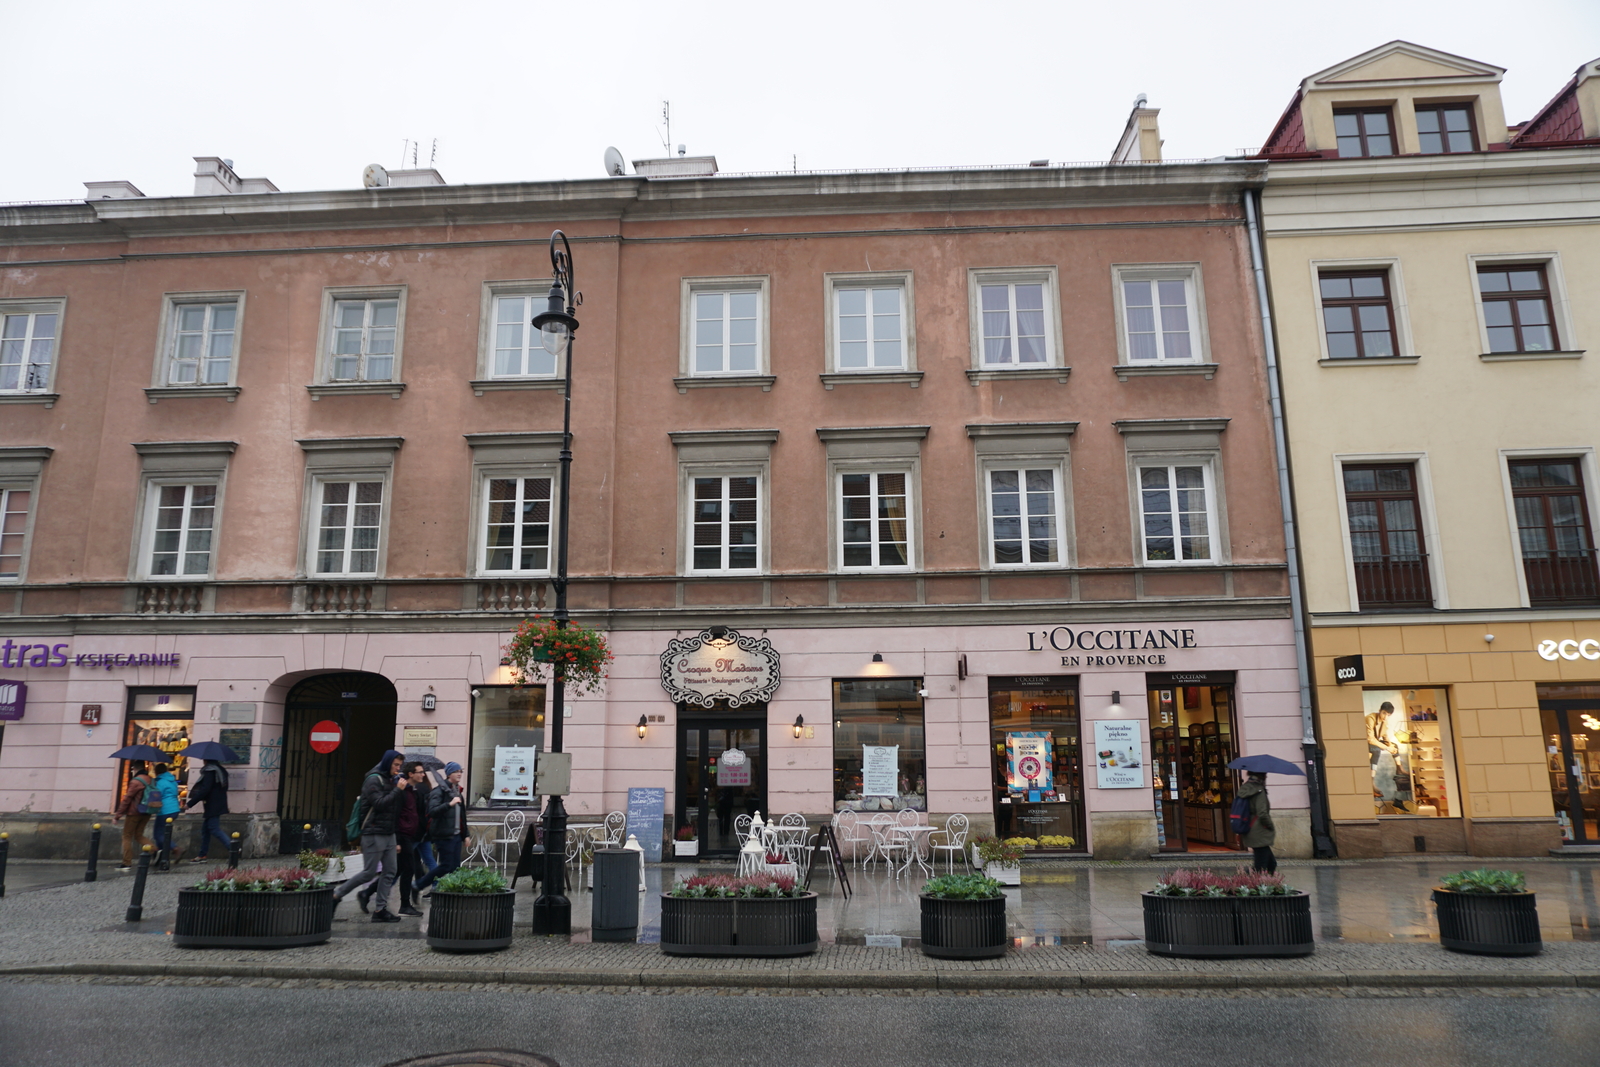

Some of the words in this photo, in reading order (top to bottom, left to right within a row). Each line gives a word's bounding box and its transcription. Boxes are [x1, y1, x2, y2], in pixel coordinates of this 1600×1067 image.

[75, 652, 181, 671] KSIĘGARNIE
[1061, 656, 1080, 666] EN
[1086, 655, 1167, 666] PROVENCE
[677, 658, 712, 676] Croque
[715, 658, 763, 673] Madame
[1338, 667, 1356, 679] ecco
[711, 676, 741, 685] Boulangerie
[84, 709, 96, 720] 41
